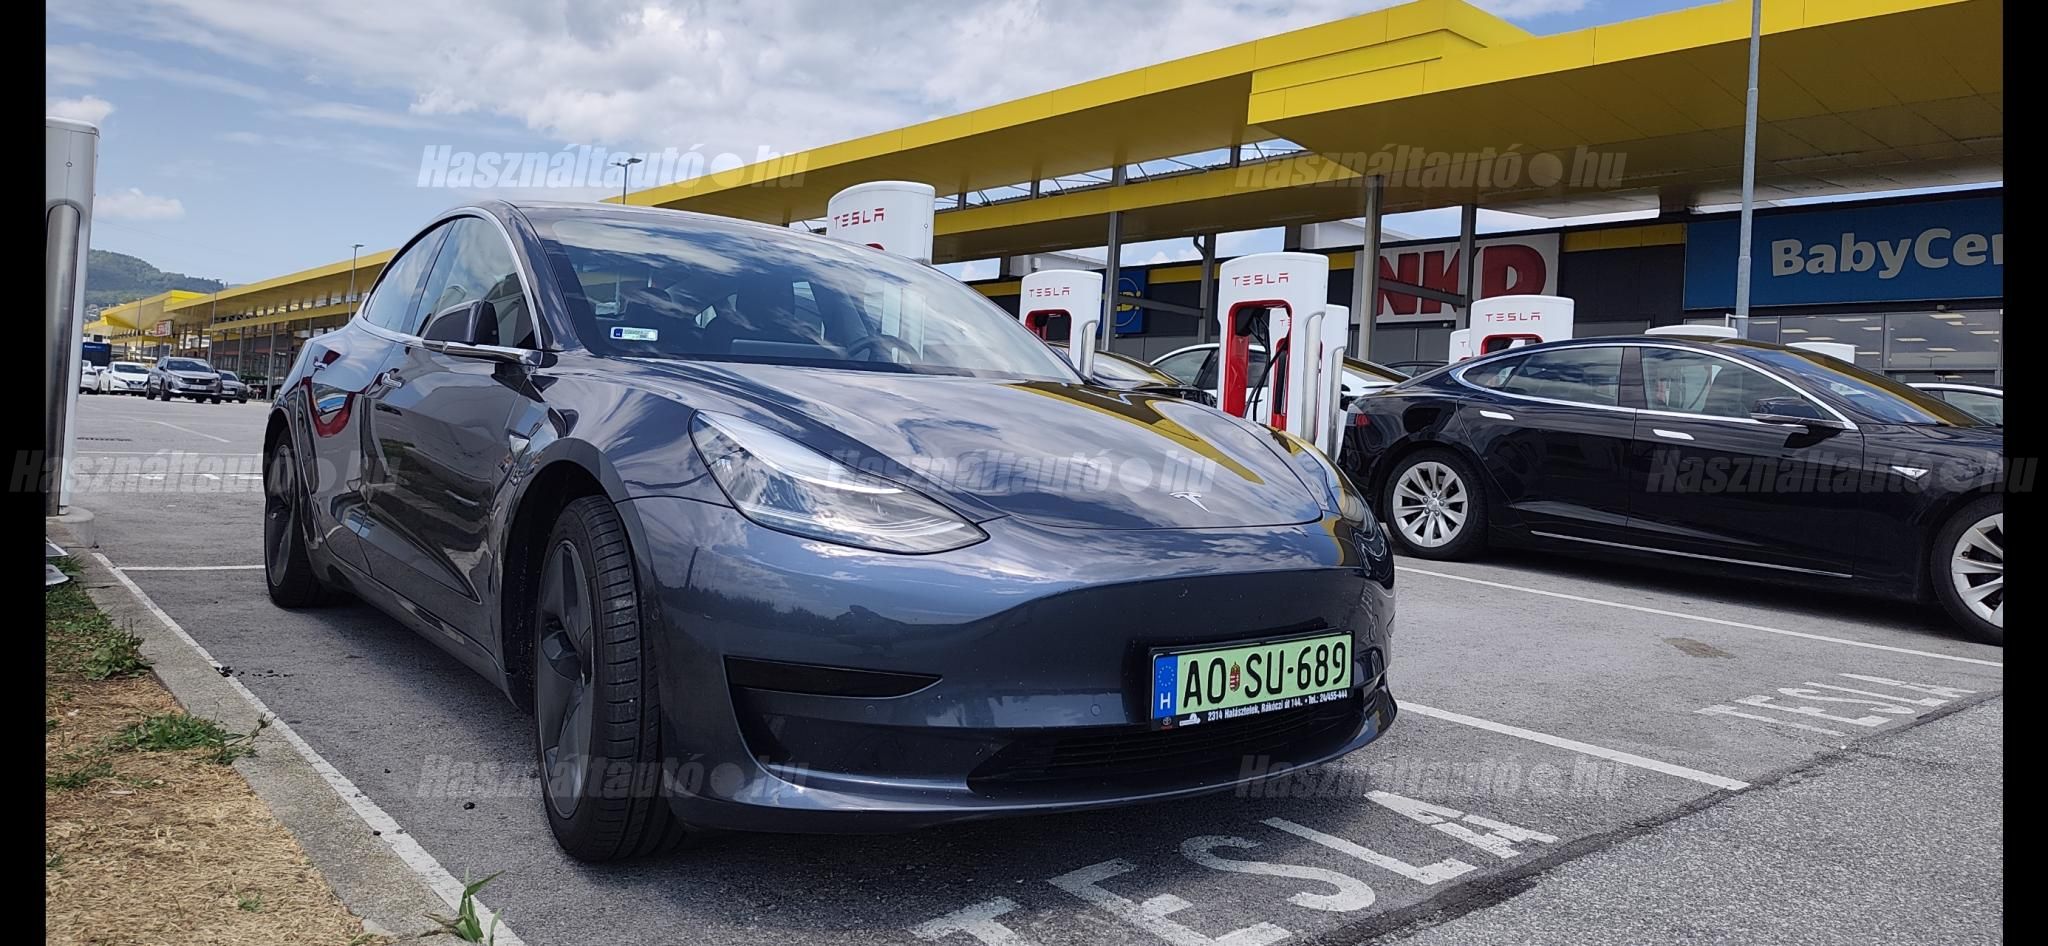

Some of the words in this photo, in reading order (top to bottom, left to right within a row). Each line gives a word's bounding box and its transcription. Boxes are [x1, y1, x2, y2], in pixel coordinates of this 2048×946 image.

[834, 207, 885, 229] TESLA
[1232, 272, 1289, 287] TESLA
[1029, 286, 1070, 298] TESLA
[1485, 312, 1541, 322] TESLA
[1160, 692, 1171, 710] H
[1693, 673, 1976, 736] TESLA
[1207, 710, 1223, 721] 2314
